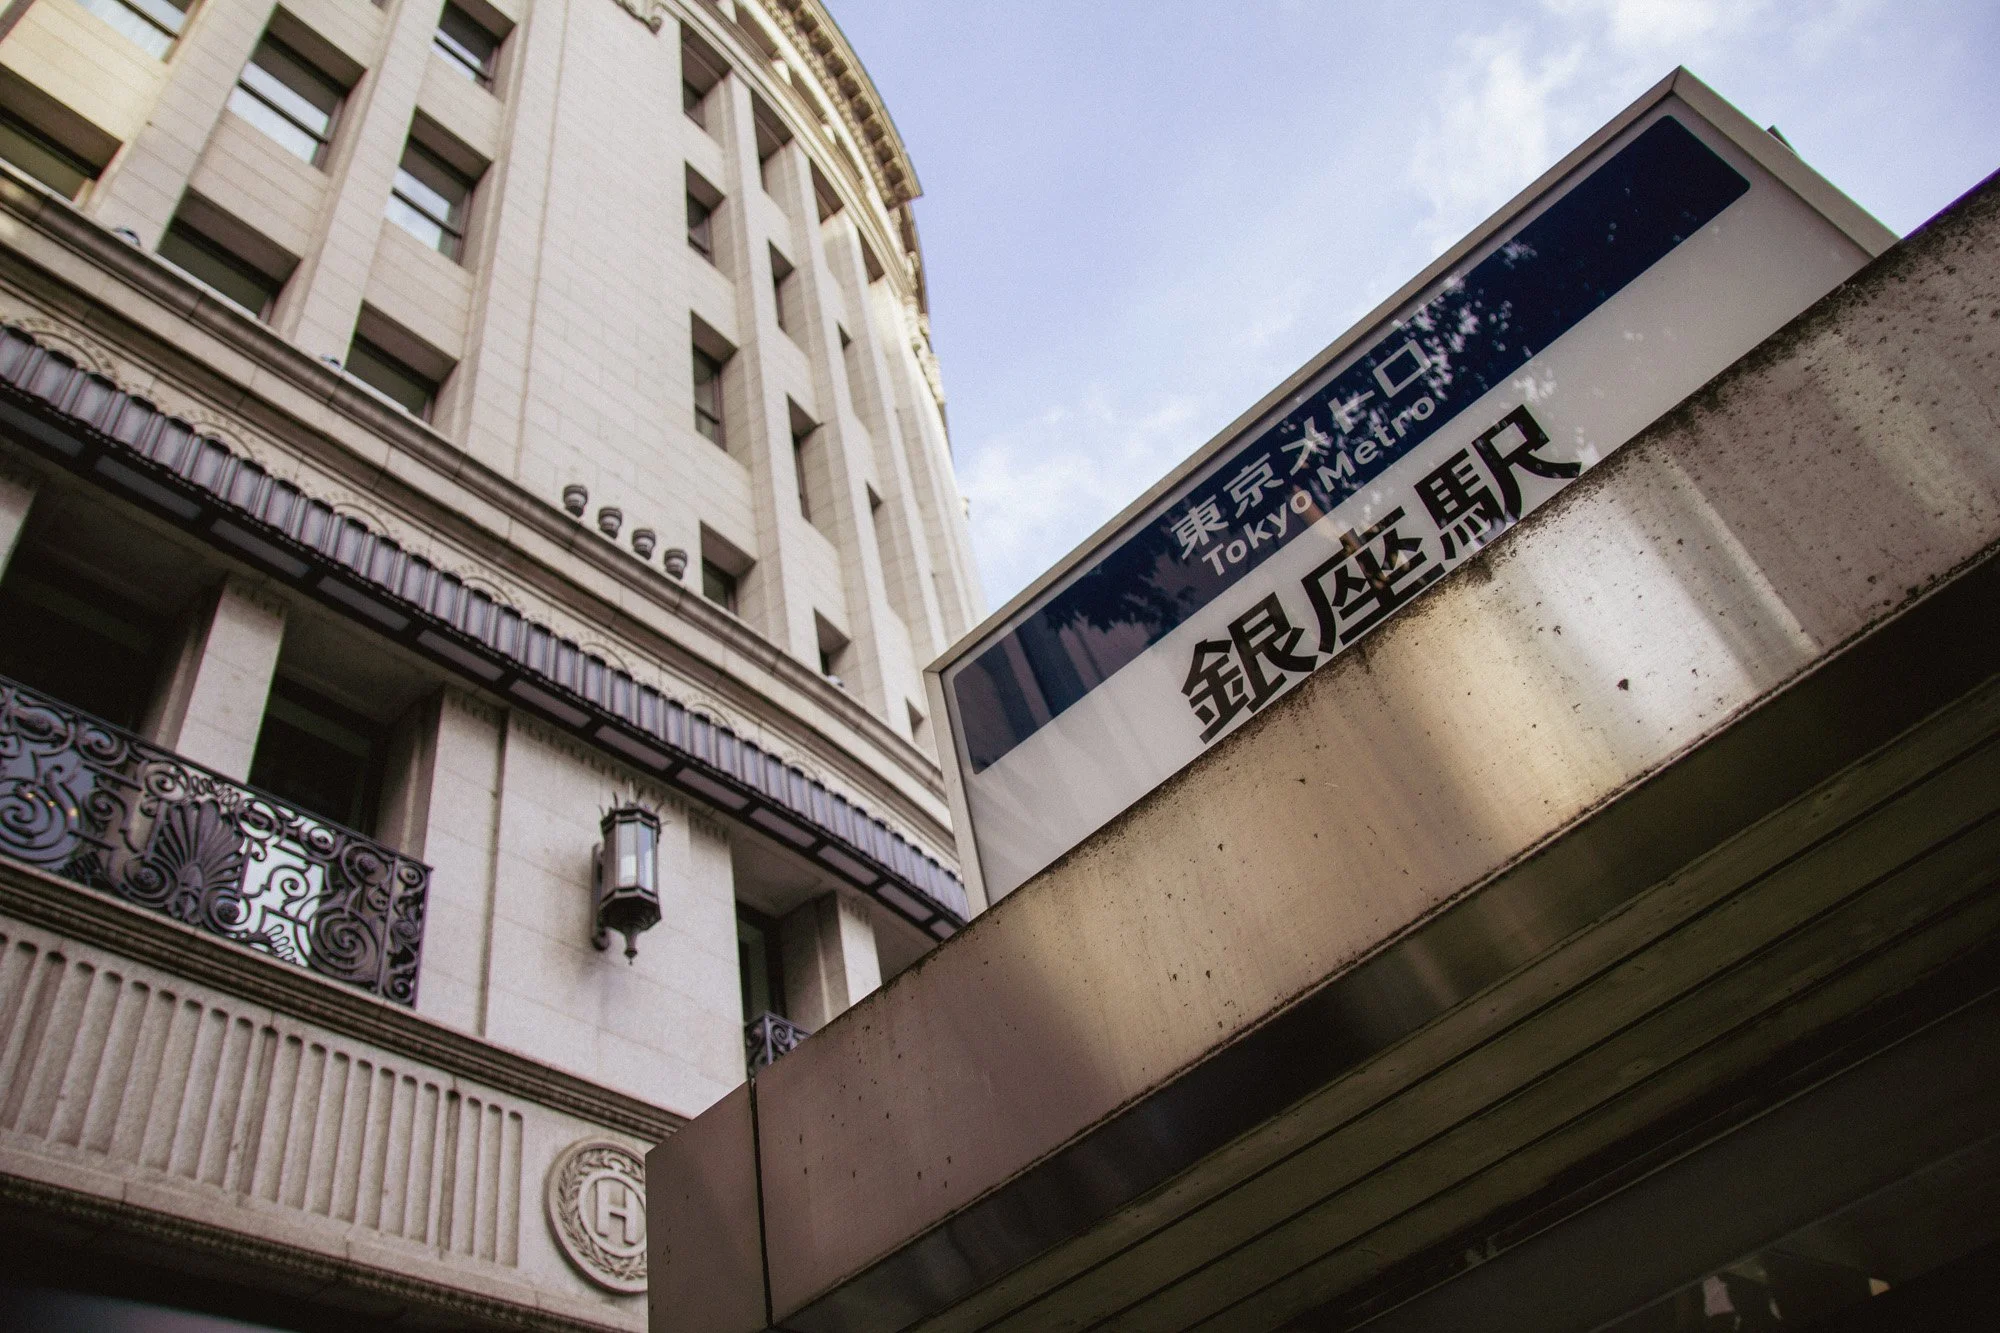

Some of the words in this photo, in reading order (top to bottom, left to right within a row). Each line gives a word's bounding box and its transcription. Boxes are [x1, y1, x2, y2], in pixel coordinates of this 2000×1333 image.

[1170, 341, 1431, 561] 東京メトロ
[1202, 489, 1314, 577] Tokyo
[1315, 396, 1436, 495] Metro
[1181, 404, 1582, 745] 銀座駅
[597, 1178, 637, 1245] H
